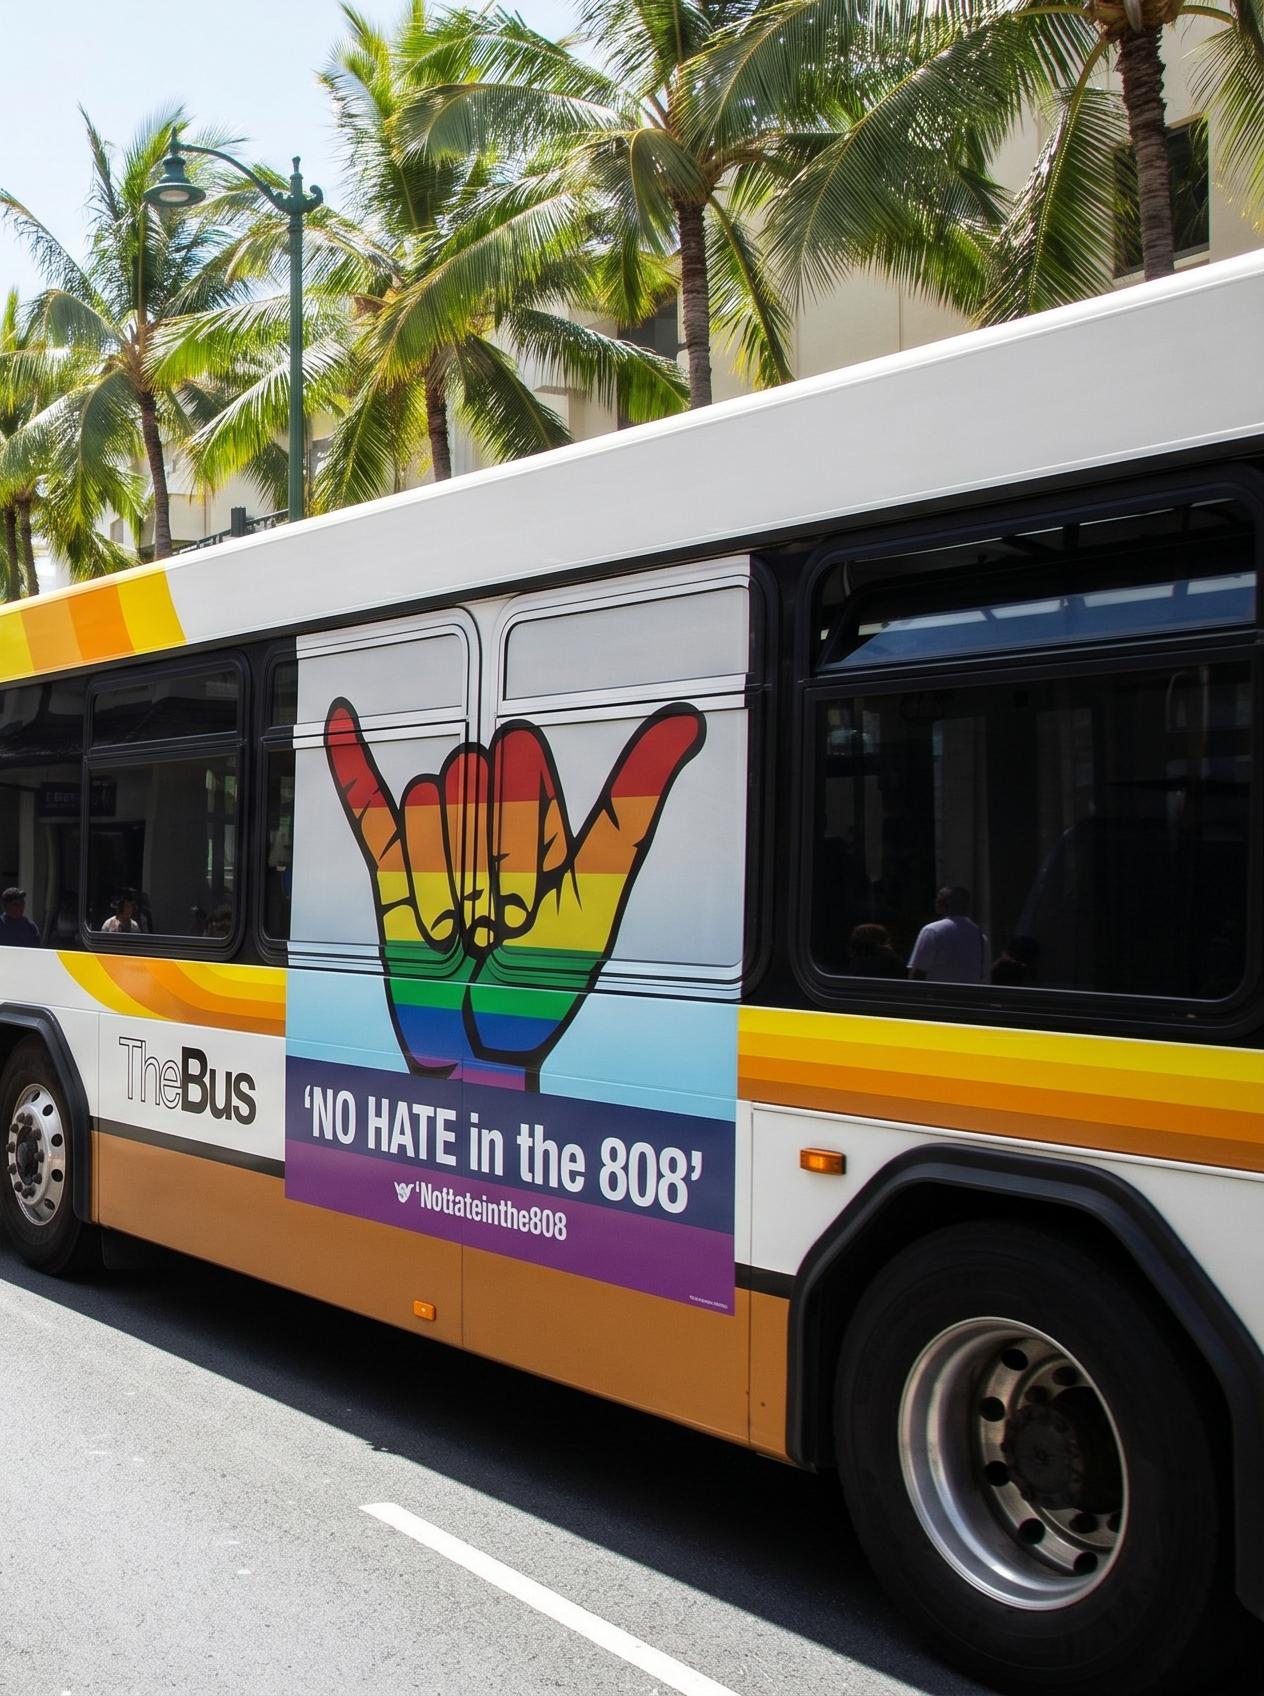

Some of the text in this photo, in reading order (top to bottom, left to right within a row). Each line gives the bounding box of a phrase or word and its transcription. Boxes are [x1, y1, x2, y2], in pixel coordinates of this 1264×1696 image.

[118, 1036, 257, 1126] TheBus
[304, 1084, 703, 1214] ‘NO HATE in the 808’
